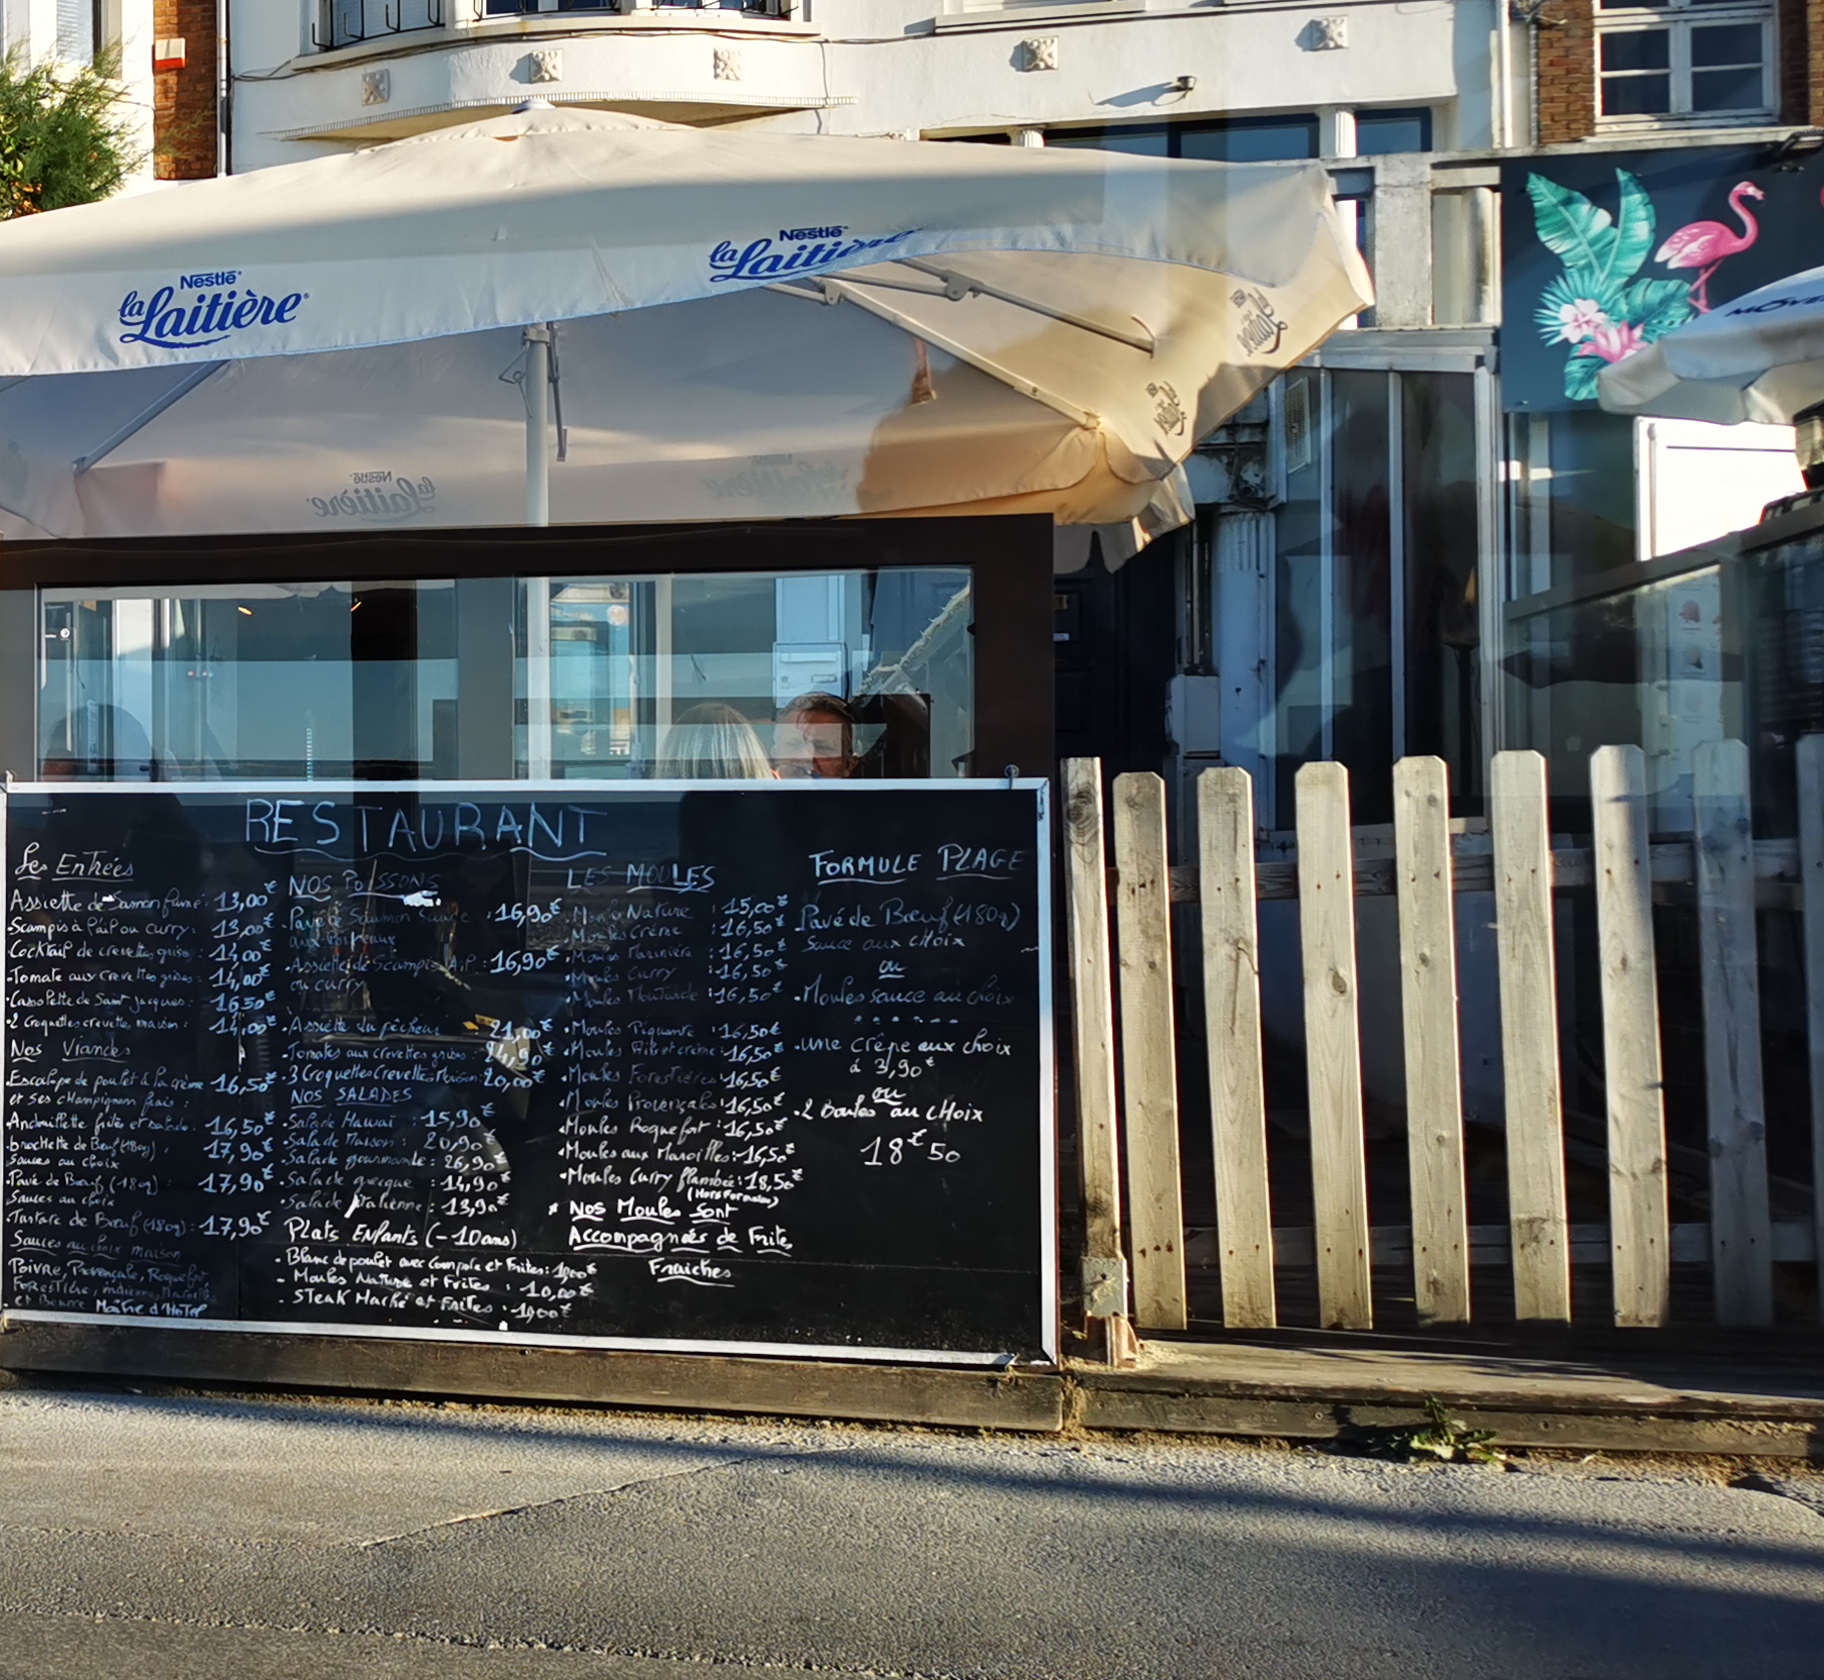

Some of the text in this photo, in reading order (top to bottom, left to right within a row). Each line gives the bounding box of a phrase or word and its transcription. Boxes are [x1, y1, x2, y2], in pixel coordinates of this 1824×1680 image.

[779, 226, 843, 241] Nestlé
[179, 271, 238, 290] Nestlé
[119, 286, 302, 349] la Laitière
[245, 798, 608, 852] RESTAURANT
[55, 851, 134, 877] Entrées
[809, 843, 1026, 877] FORMULE PLAGE
[627, 863, 716, 890] MOULES
[11, 1040, 42, 1057] Nos
[290, 1086, 413, 1104] NOS SALADES
